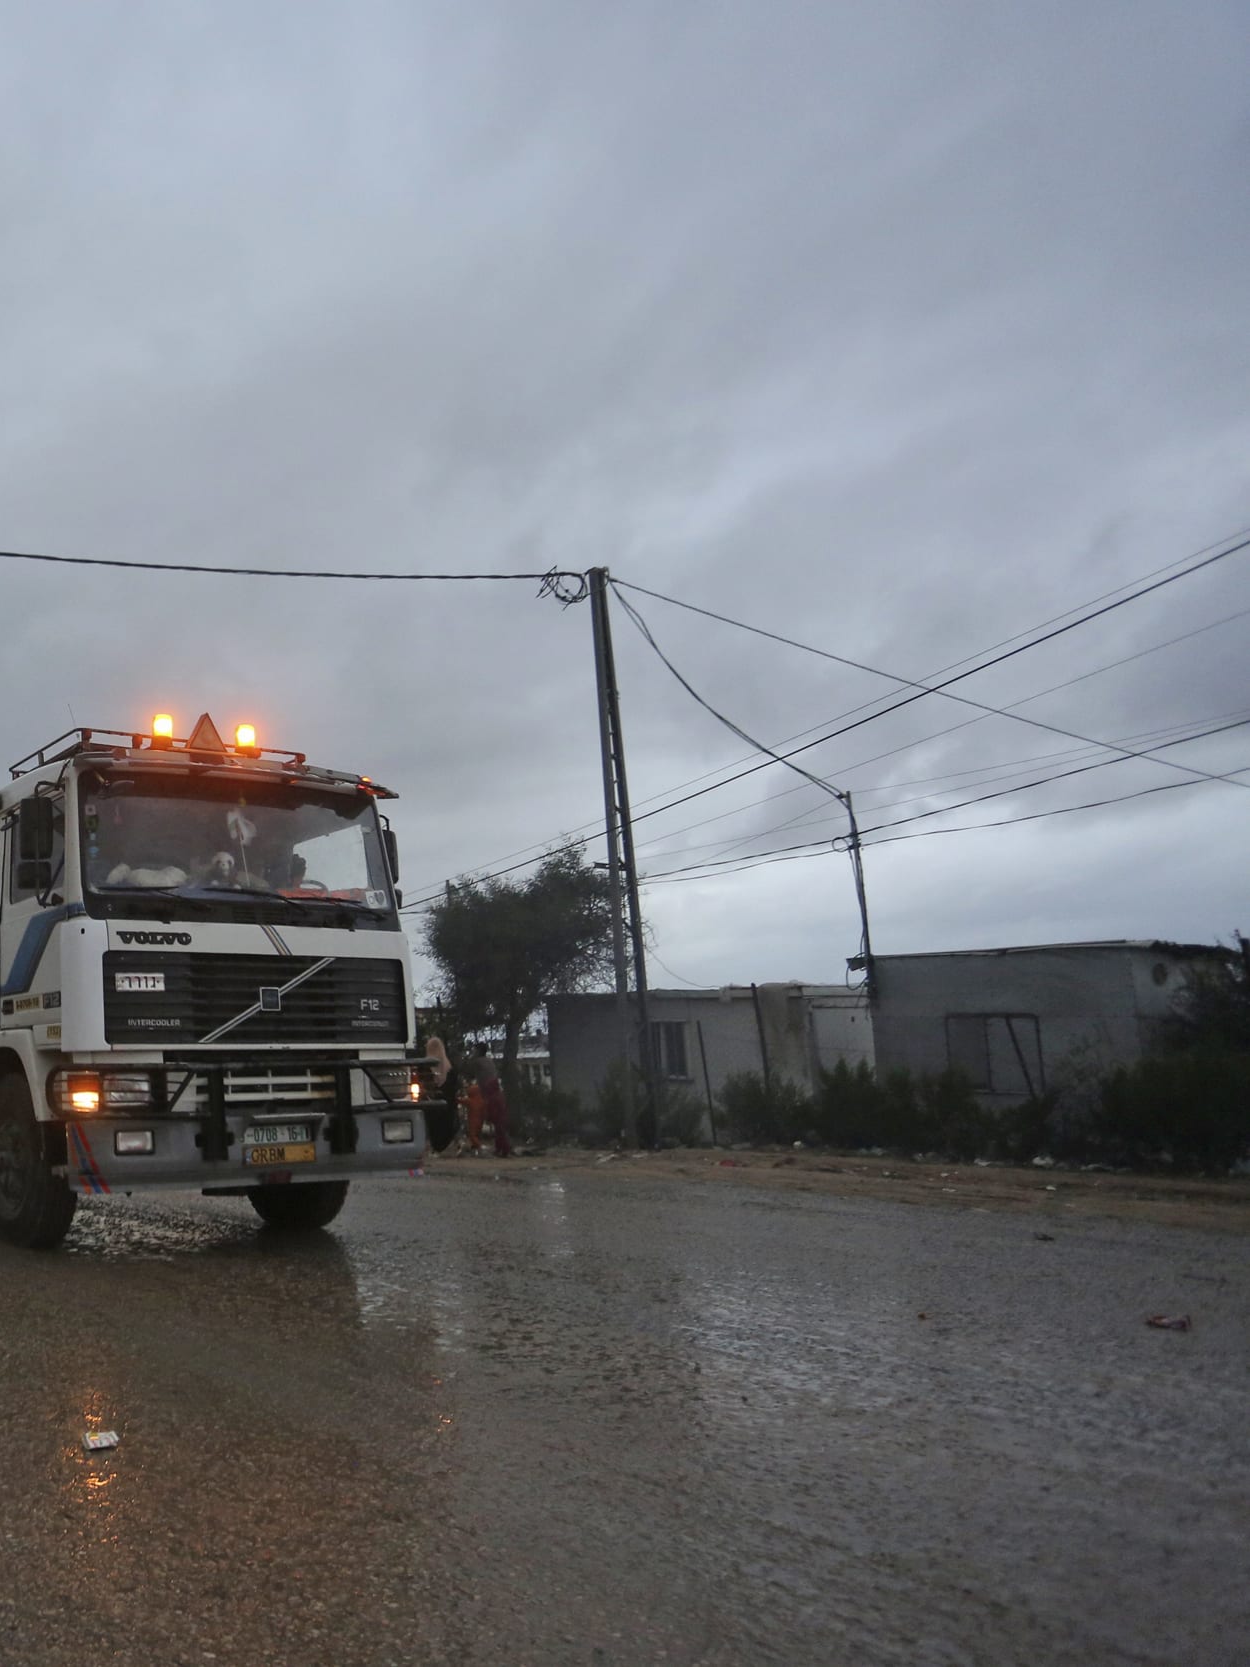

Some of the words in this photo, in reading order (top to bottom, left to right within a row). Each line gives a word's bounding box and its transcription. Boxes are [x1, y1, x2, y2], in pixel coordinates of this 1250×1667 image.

[116, 931, 192, 945] VOLVO
[360, 999, 380, 1011] F12
[127, 1018, 181, 1027] INTERCOOLER
